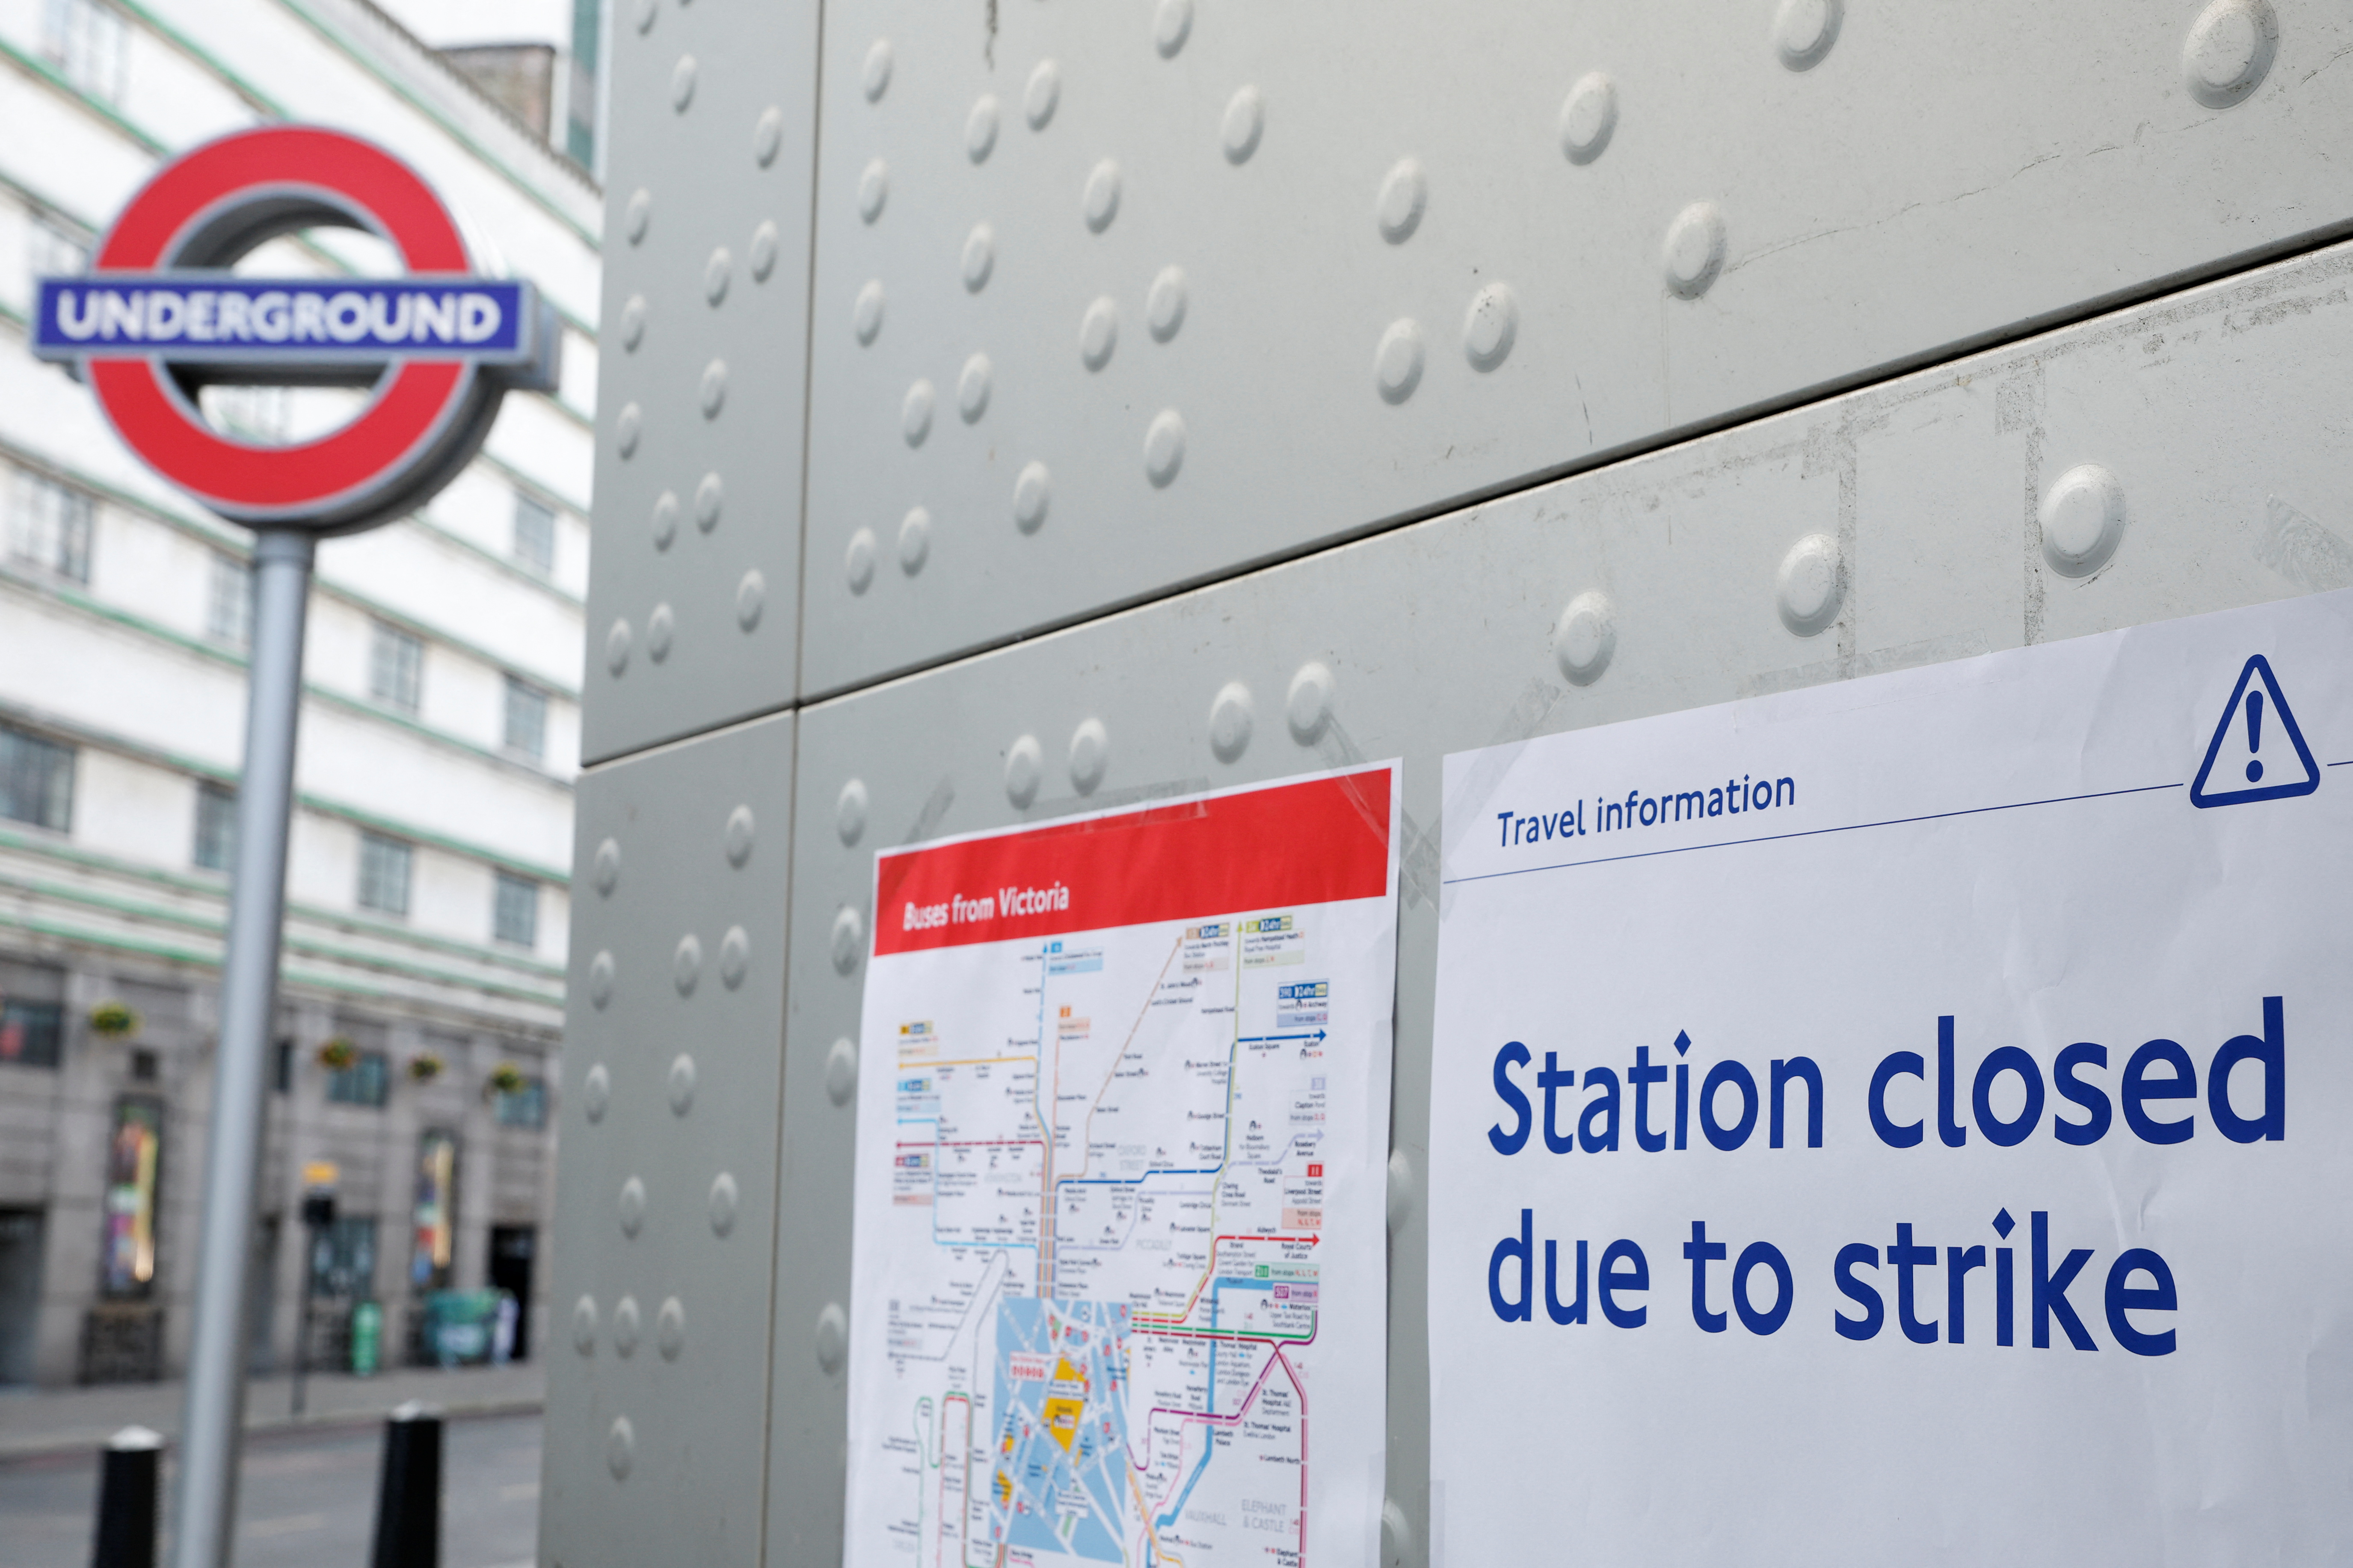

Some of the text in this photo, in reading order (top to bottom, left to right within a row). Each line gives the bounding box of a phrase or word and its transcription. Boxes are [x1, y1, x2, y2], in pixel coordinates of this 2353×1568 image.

[57, 291, 501, 342] UNDERGROUND
[1498, 774, 1795, 847] Travel information
[903, 880, 1070, 931] Buses from Victoria
[1488, 995, 2285, 1156] Station closed
[1488, 1207, 2178, 1356] due to strike
[1241, 1499, 1287, 1515] ELEPHANT
[1251, 1517, 1284, 1532] CASTLE
